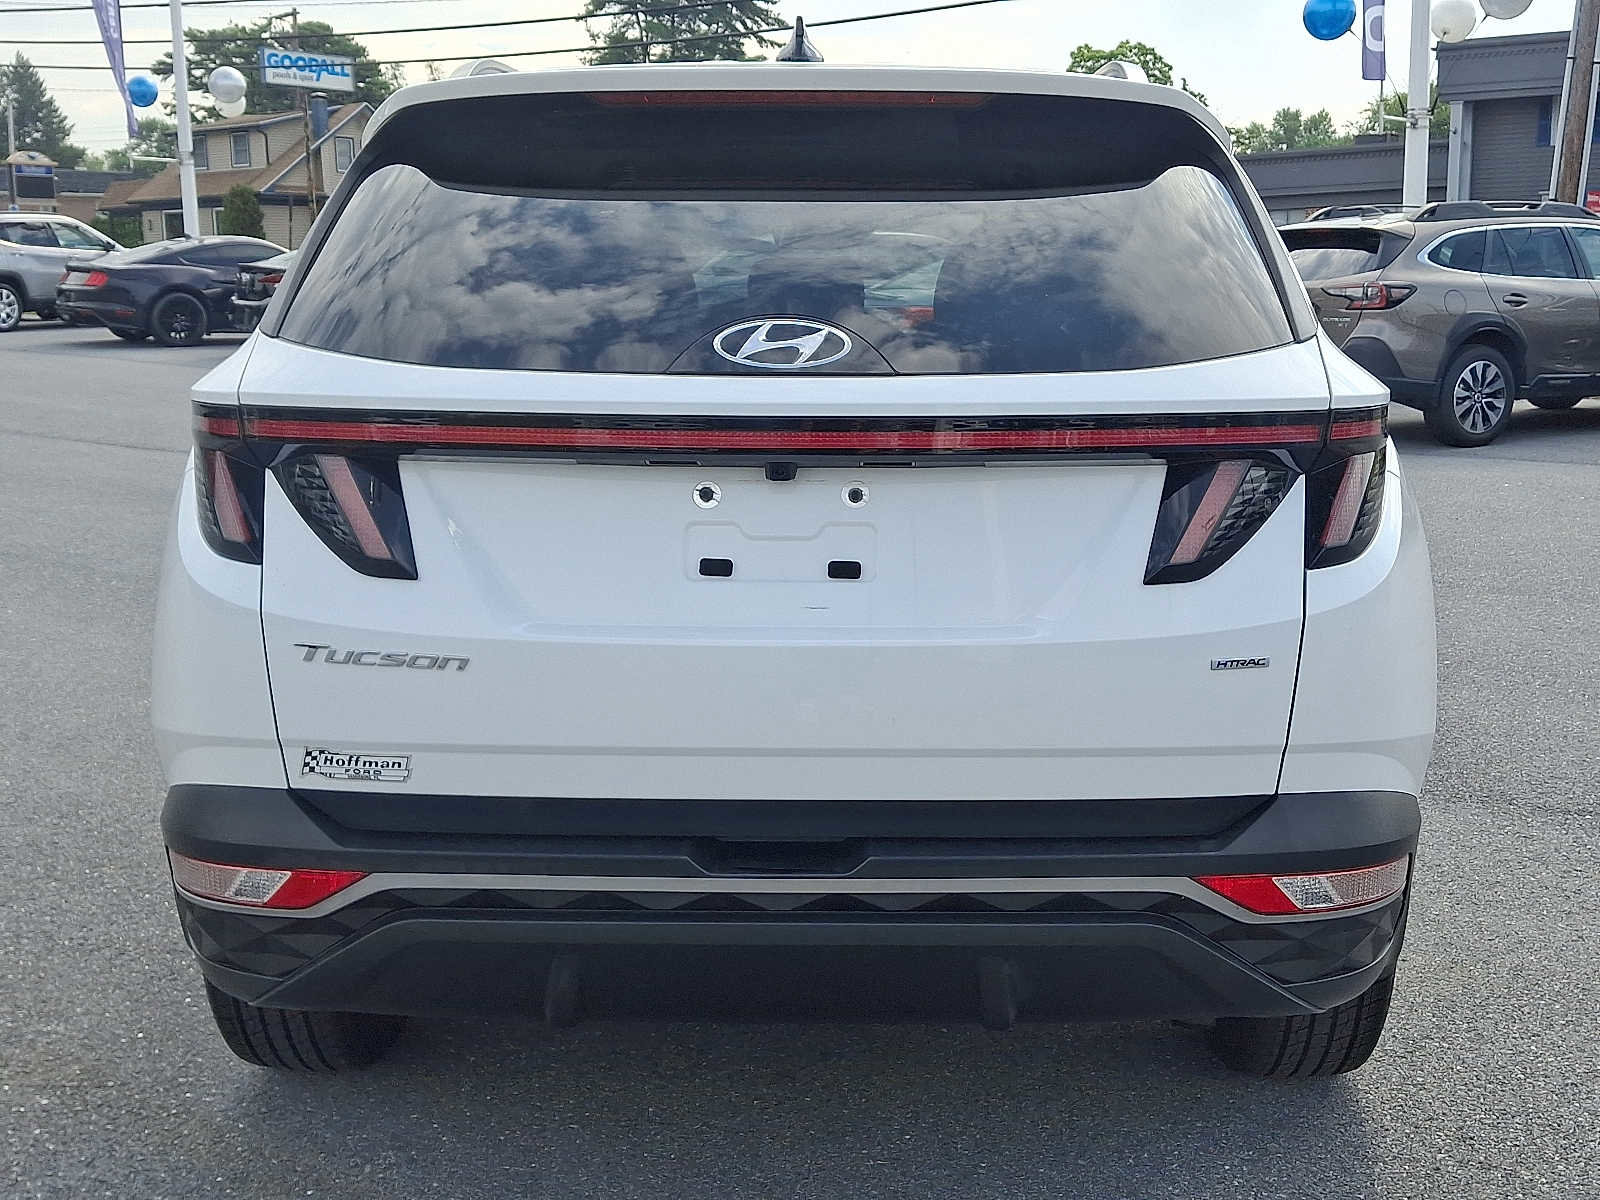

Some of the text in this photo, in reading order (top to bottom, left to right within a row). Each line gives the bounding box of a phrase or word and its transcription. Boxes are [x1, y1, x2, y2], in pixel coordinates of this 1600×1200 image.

[266, 52, 350, 81] GOODALL
[293, 641, 470, 671] Tucson
[1216, 657, 1266, 668] HTRAC
[323, 755, 402, 769] Hoffman
